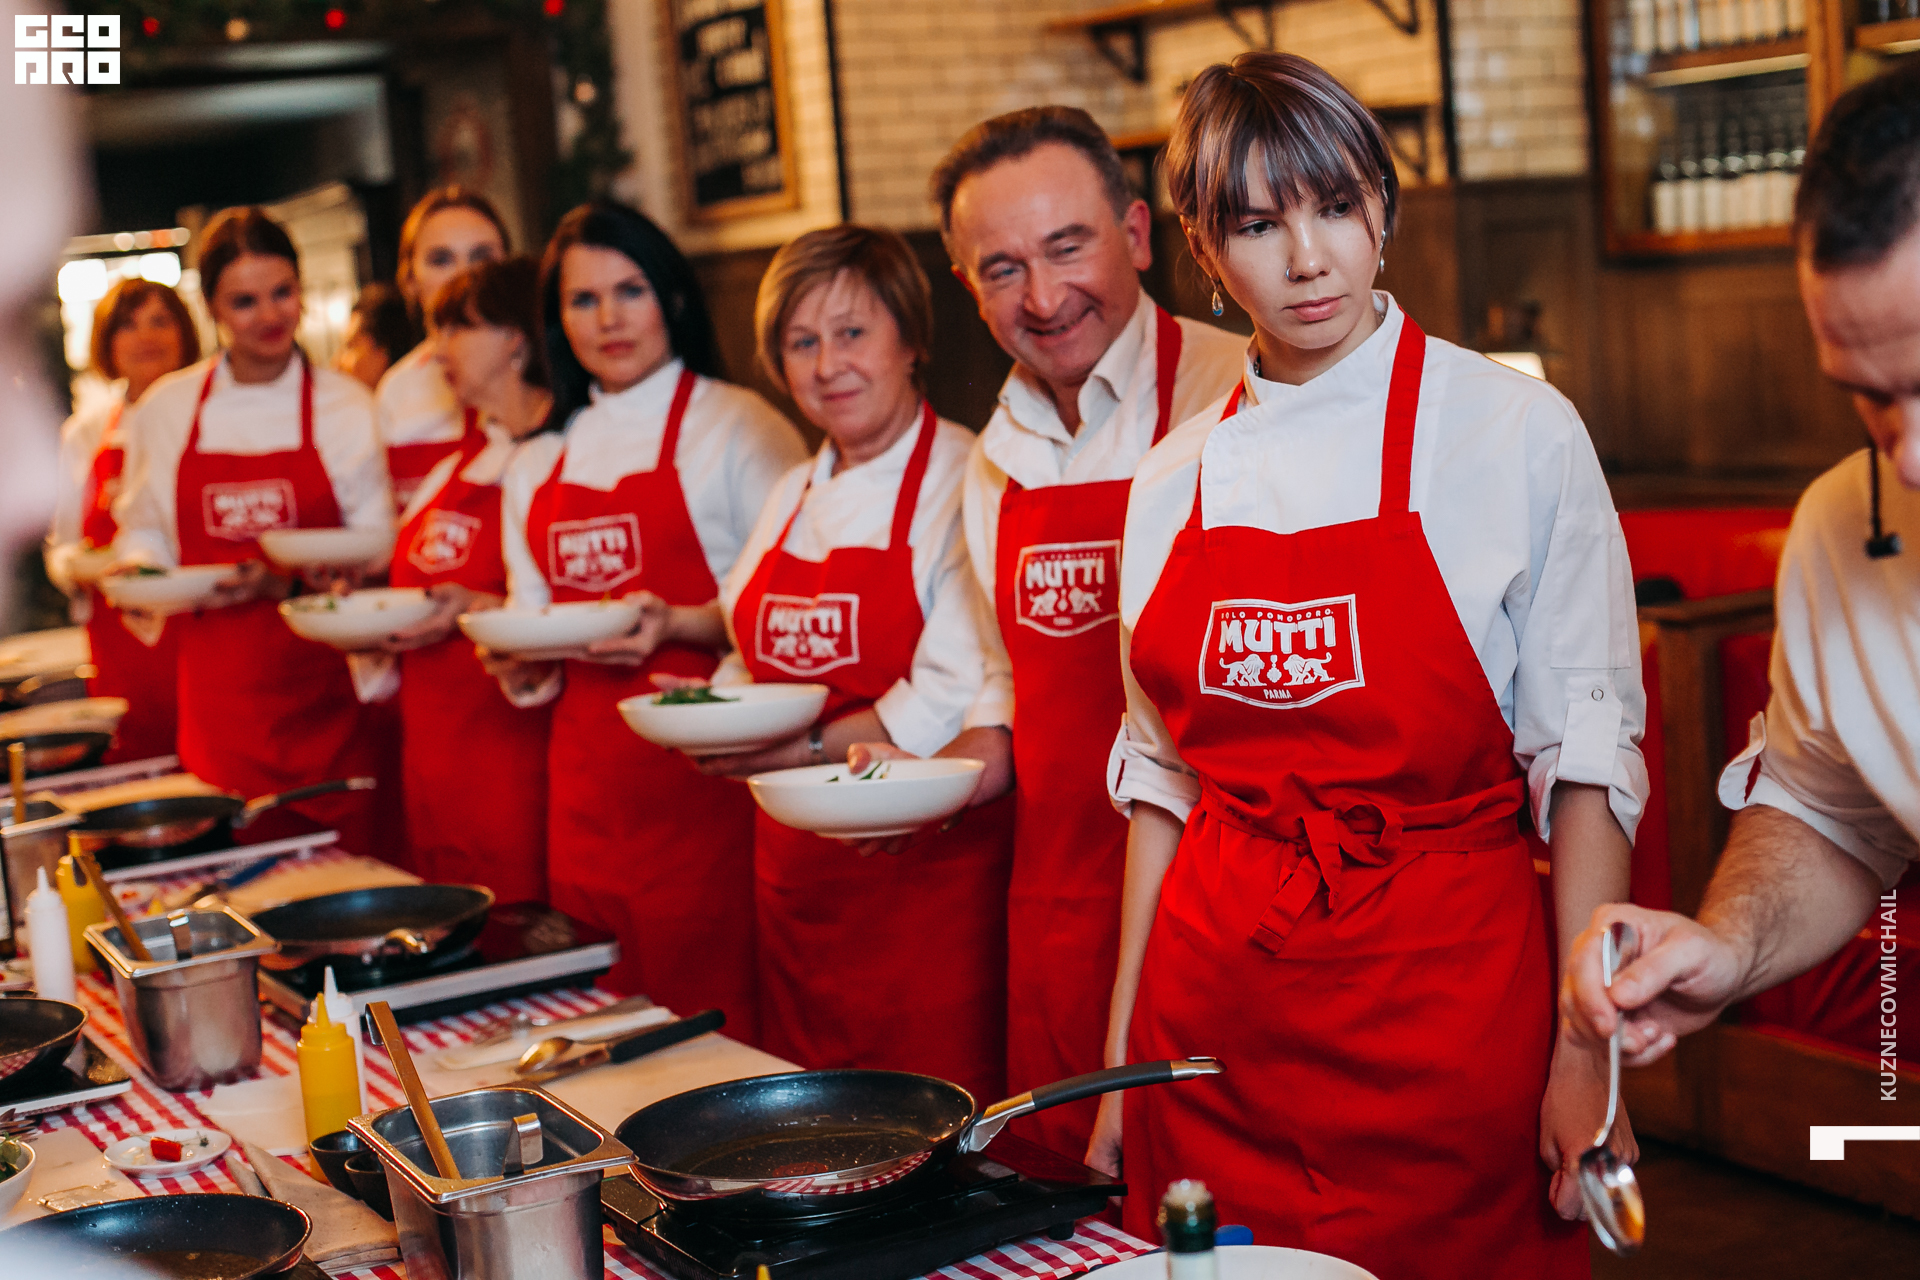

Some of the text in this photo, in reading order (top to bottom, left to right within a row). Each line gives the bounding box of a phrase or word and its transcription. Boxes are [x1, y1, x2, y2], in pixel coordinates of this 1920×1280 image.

[1025, 557, 1106, 590] MUTTI
[1218, 615, 1337, 655] MUTTI
[1263, 688, 1293, 700] PARMA
